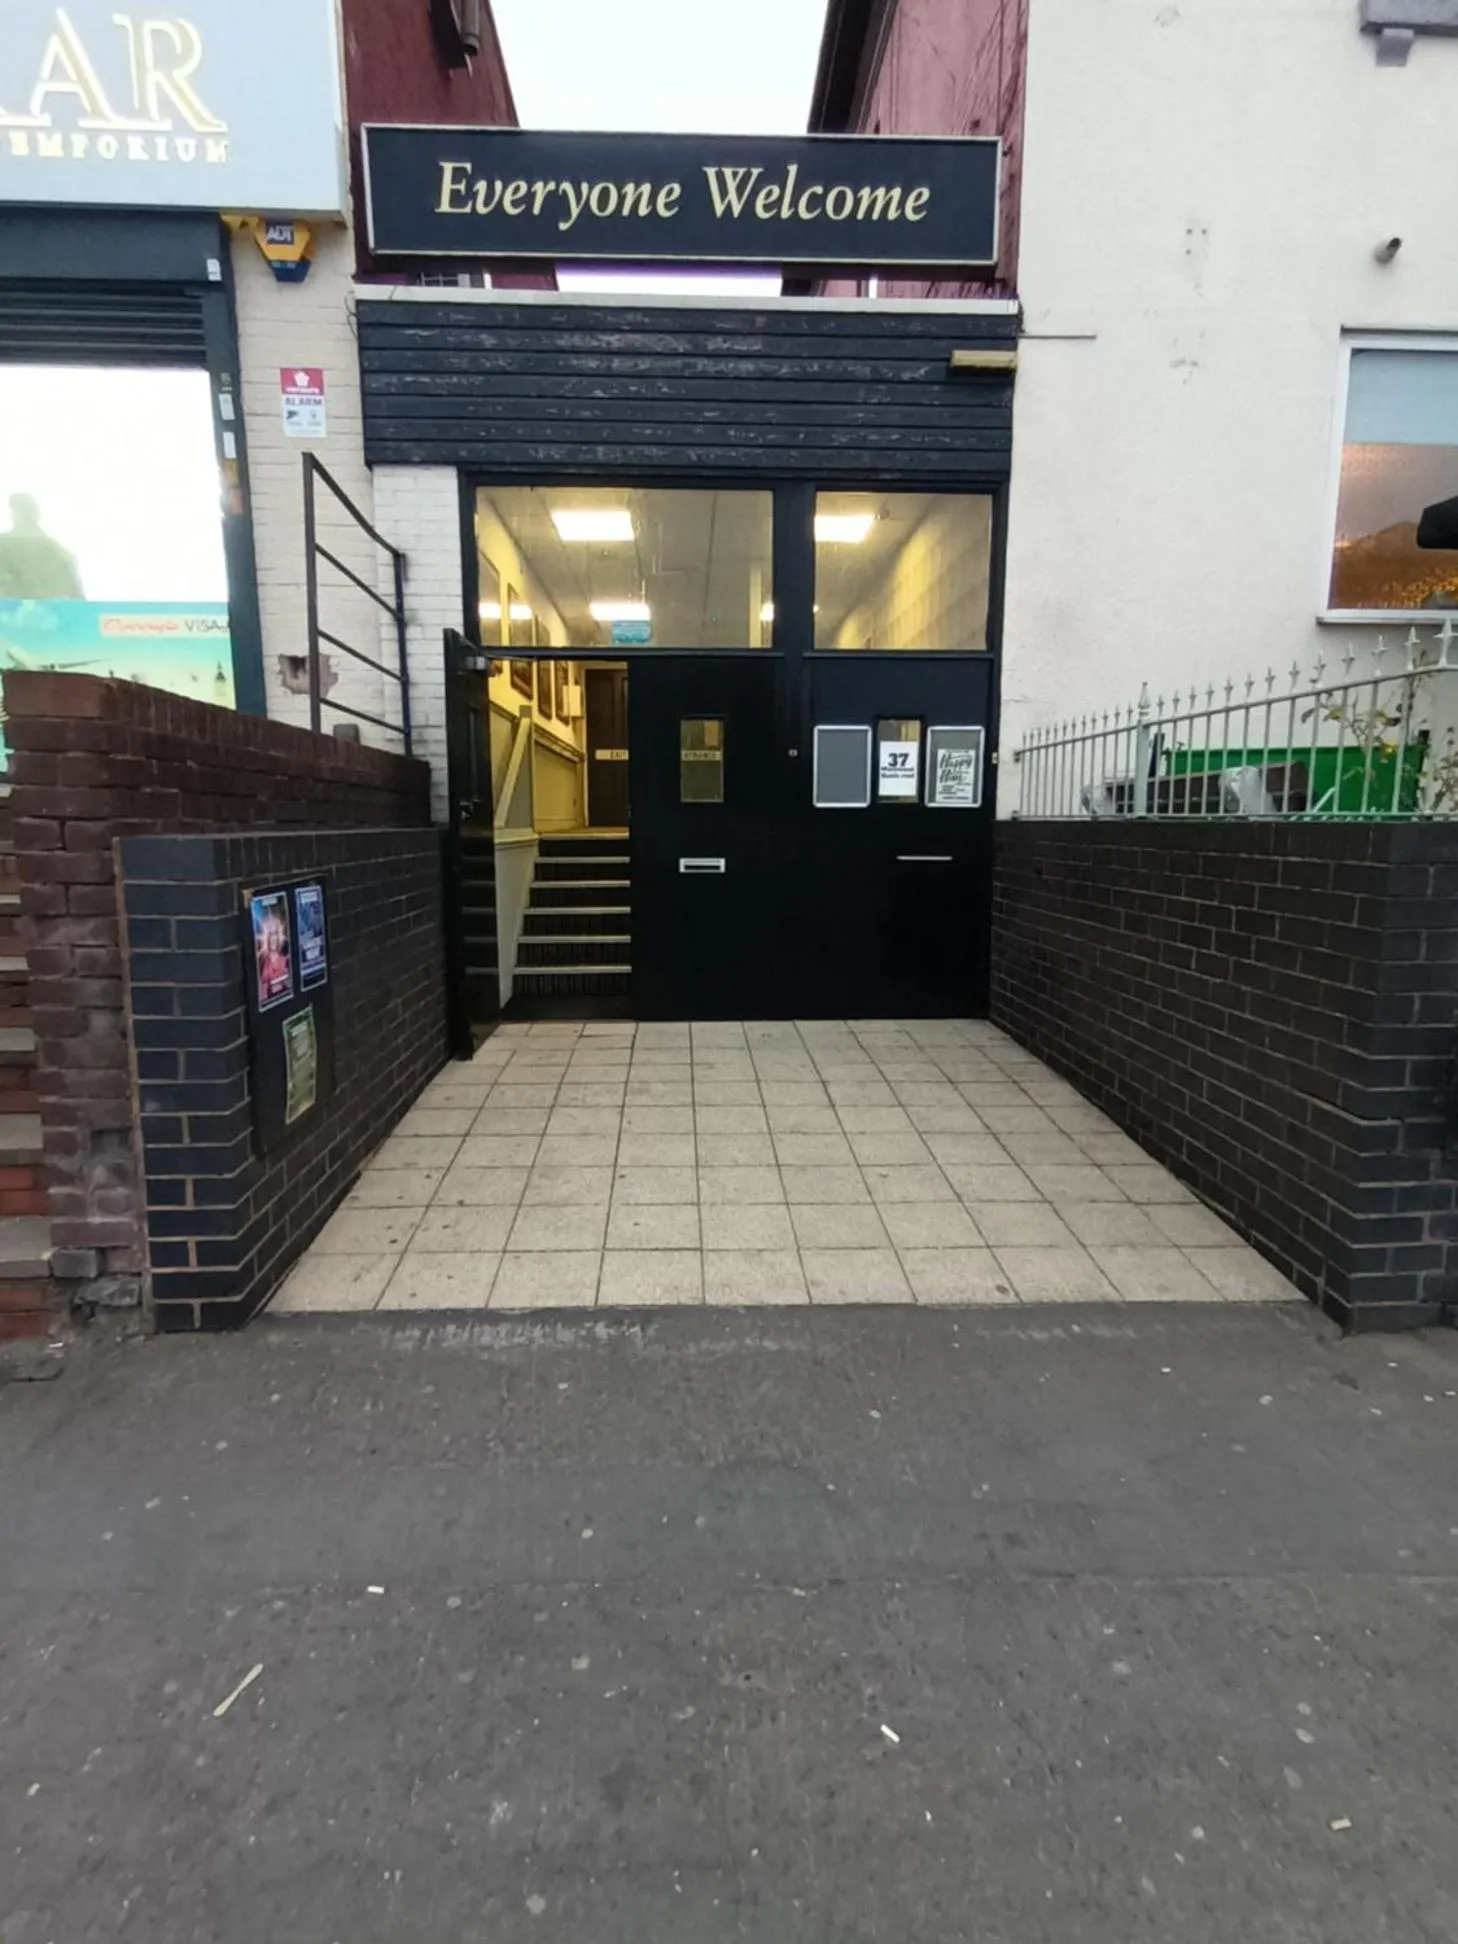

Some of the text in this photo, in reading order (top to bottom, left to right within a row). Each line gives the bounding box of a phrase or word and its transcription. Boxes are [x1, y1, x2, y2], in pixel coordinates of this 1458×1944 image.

[0, 7, 228, 133] AR
[8, 131, 230, 163] EMPORIUM
[434, 160, 931, 231] Everyone Welcome
[267, 225, 293, 242] ADT
[888, 752, 910, 767] 37
